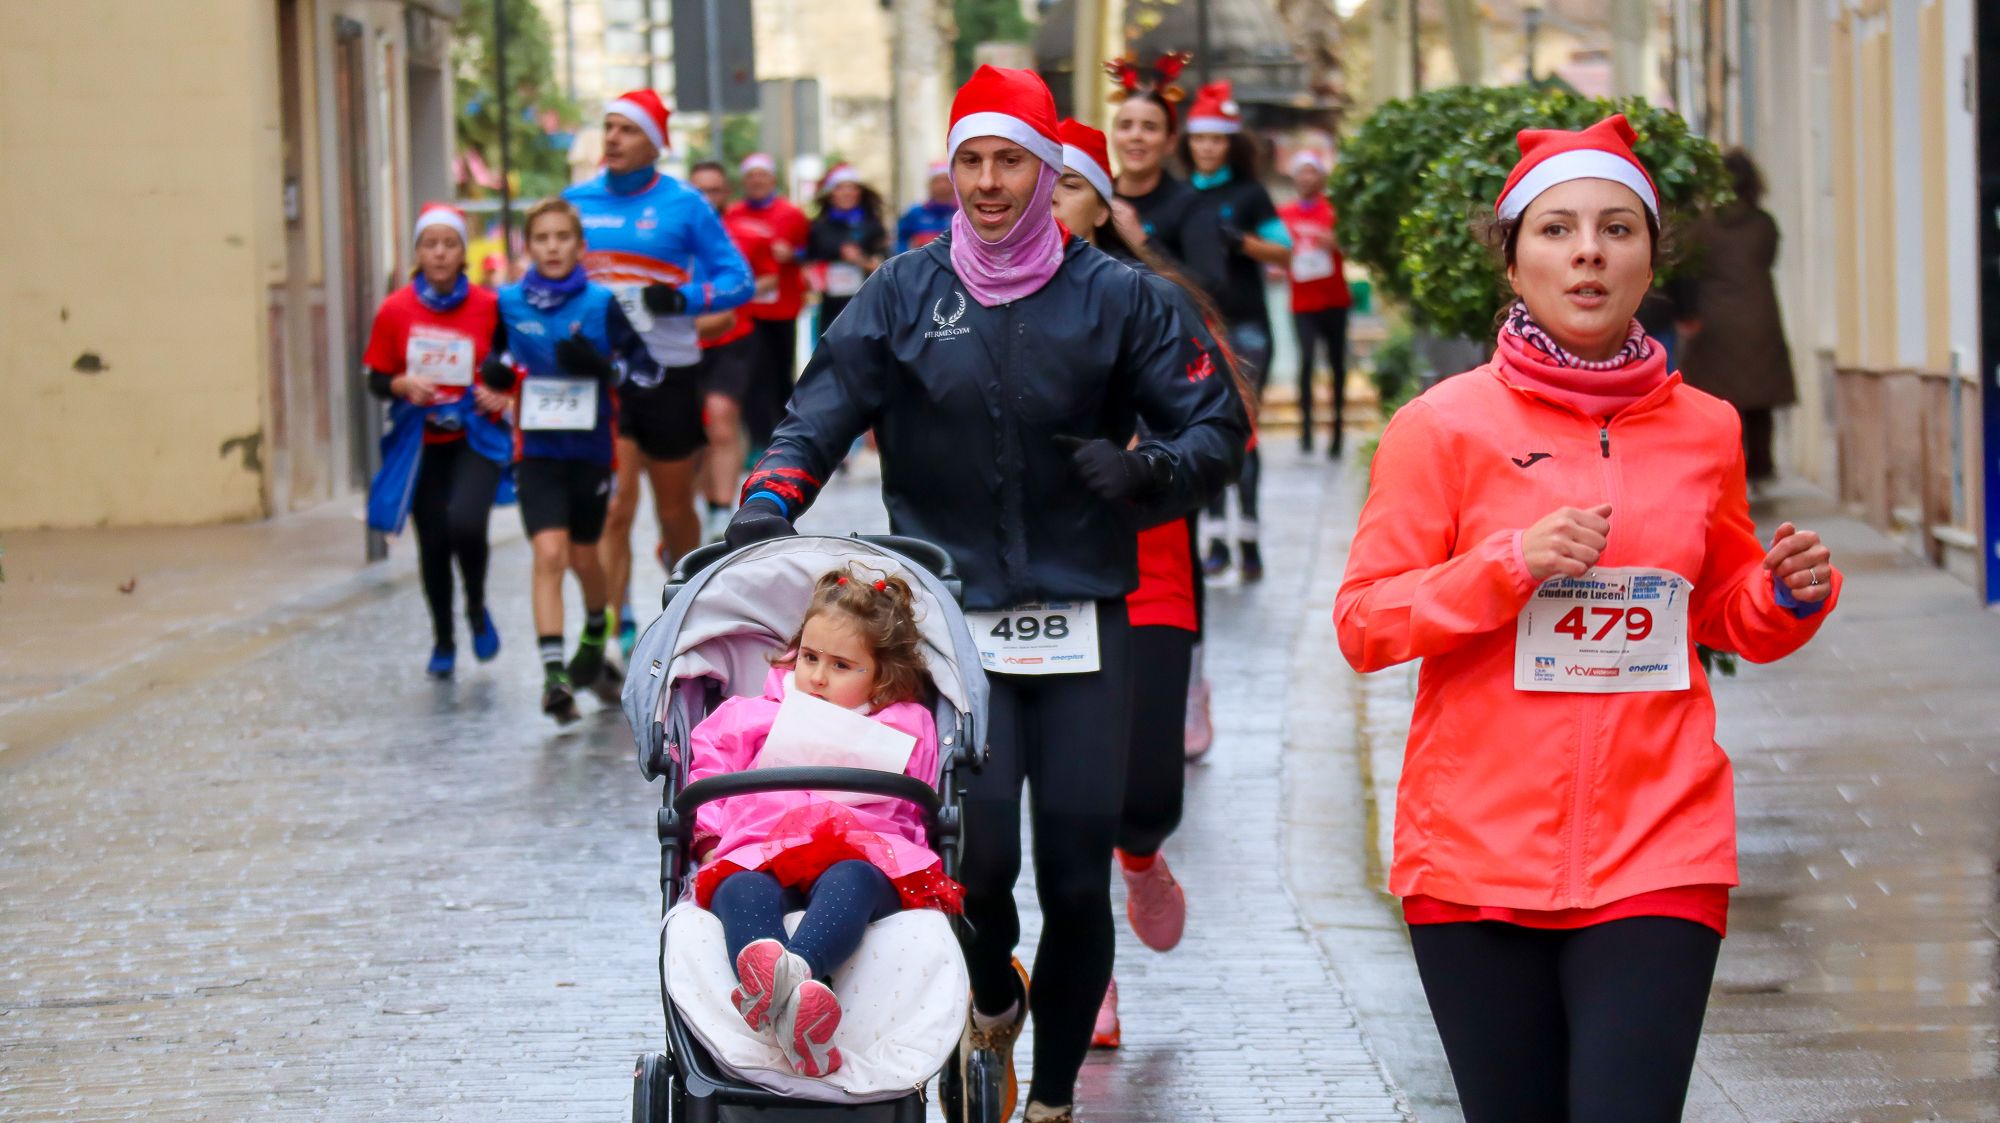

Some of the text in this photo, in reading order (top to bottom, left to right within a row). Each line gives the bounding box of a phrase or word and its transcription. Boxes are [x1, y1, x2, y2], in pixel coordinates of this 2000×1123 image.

[924, 327, 970, 339] HERMES GYM
[421, 352, 459, 366] 274
[1561, 577, 1606, 590] Silvestre
[1537, 589, 1573, 599] Ciudad
[1575, 589, 1588, 599] de
[990, 614, 1070, 642] 498
[1554, 606, 1653, 642] 479
[1628, 663, 1669, 673] enerplus
